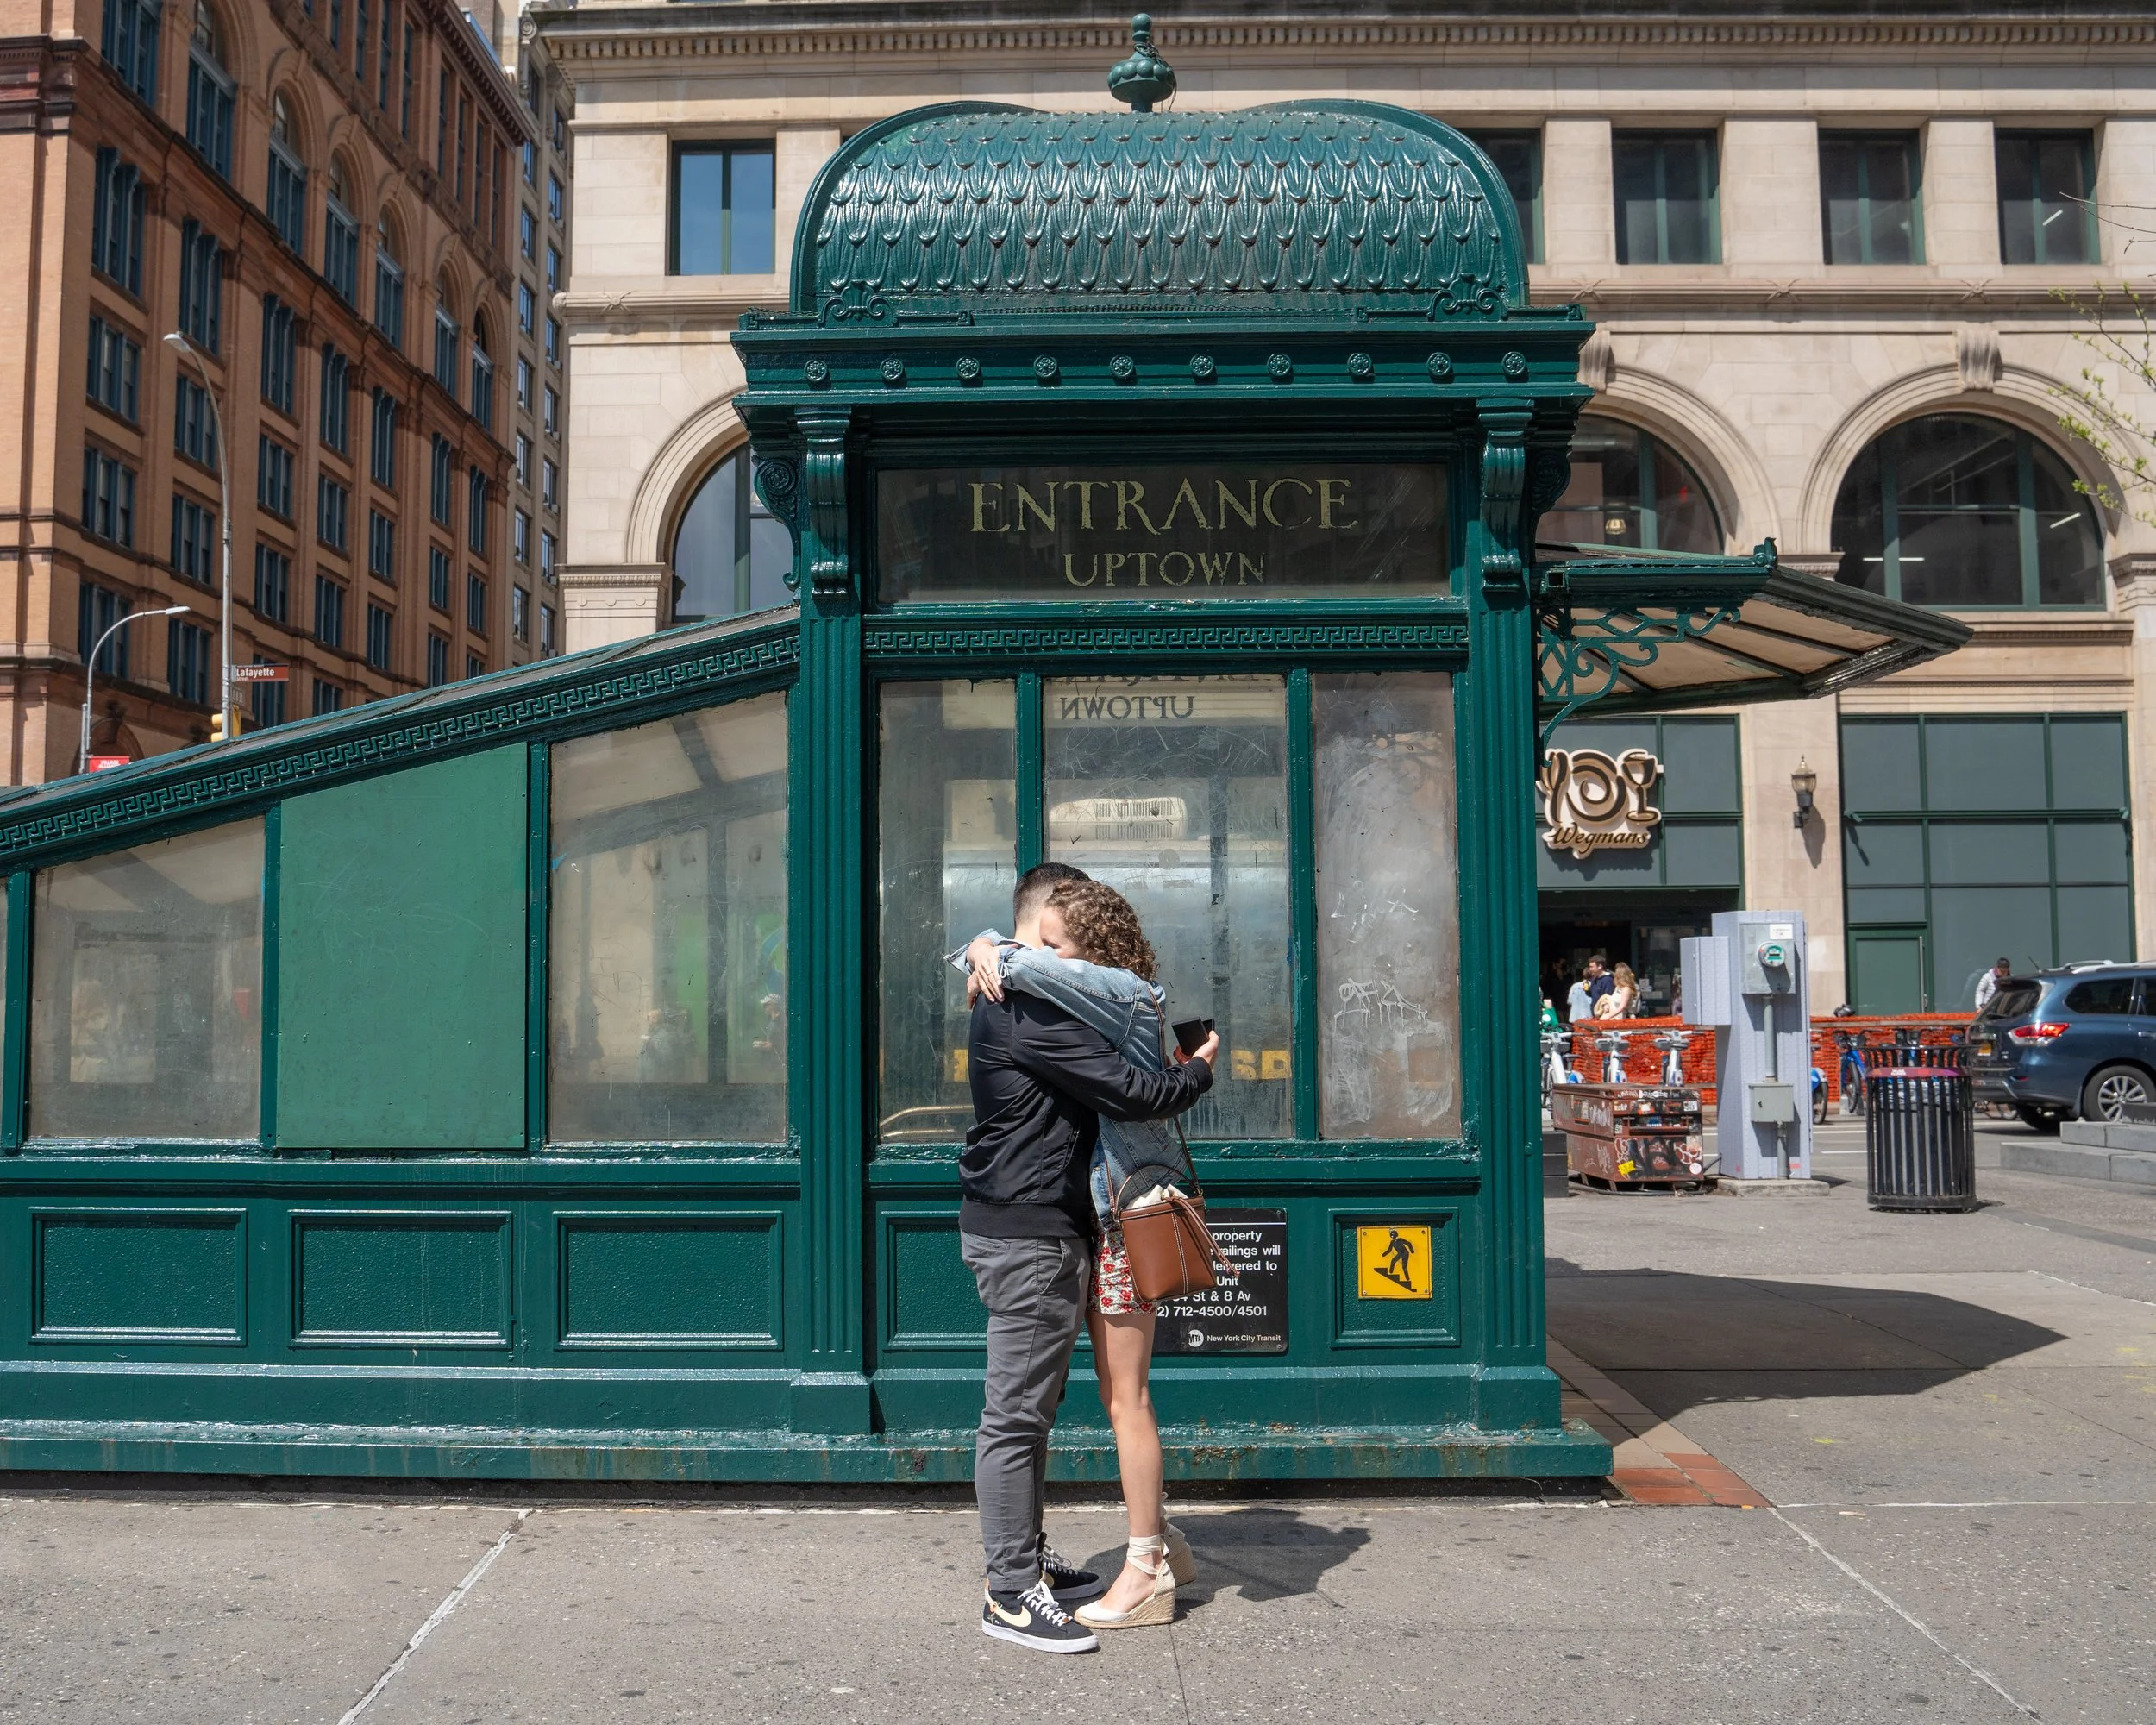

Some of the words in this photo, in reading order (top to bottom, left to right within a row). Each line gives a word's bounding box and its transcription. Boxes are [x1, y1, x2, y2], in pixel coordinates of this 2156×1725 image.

[968, 477, 1359, 536] ENTRANCE
[1062, 551, 1266, 588] UPTOWN
[236, 668, 275, 679] Lafayette
[1550, 822, 1648, 854] Wegmans
[1212, 1231, 1262, 1243] property
[1262, 1245, 1281, 1255] will
[1265, 1260, 1277, 1270] to
[1216, 1276, 1239, 1286] Unit
[1192, 1291, 1206, 1302] St
[1210, 1290, 1219, 1301] &
[1224, 1290, 1232, 1301] 8
[1237, 1290, 1251, 1301] Av
[1173, 1305, 1267, 1317] 712-4500/4501
[1240, 1334, 1256, 1343] City
